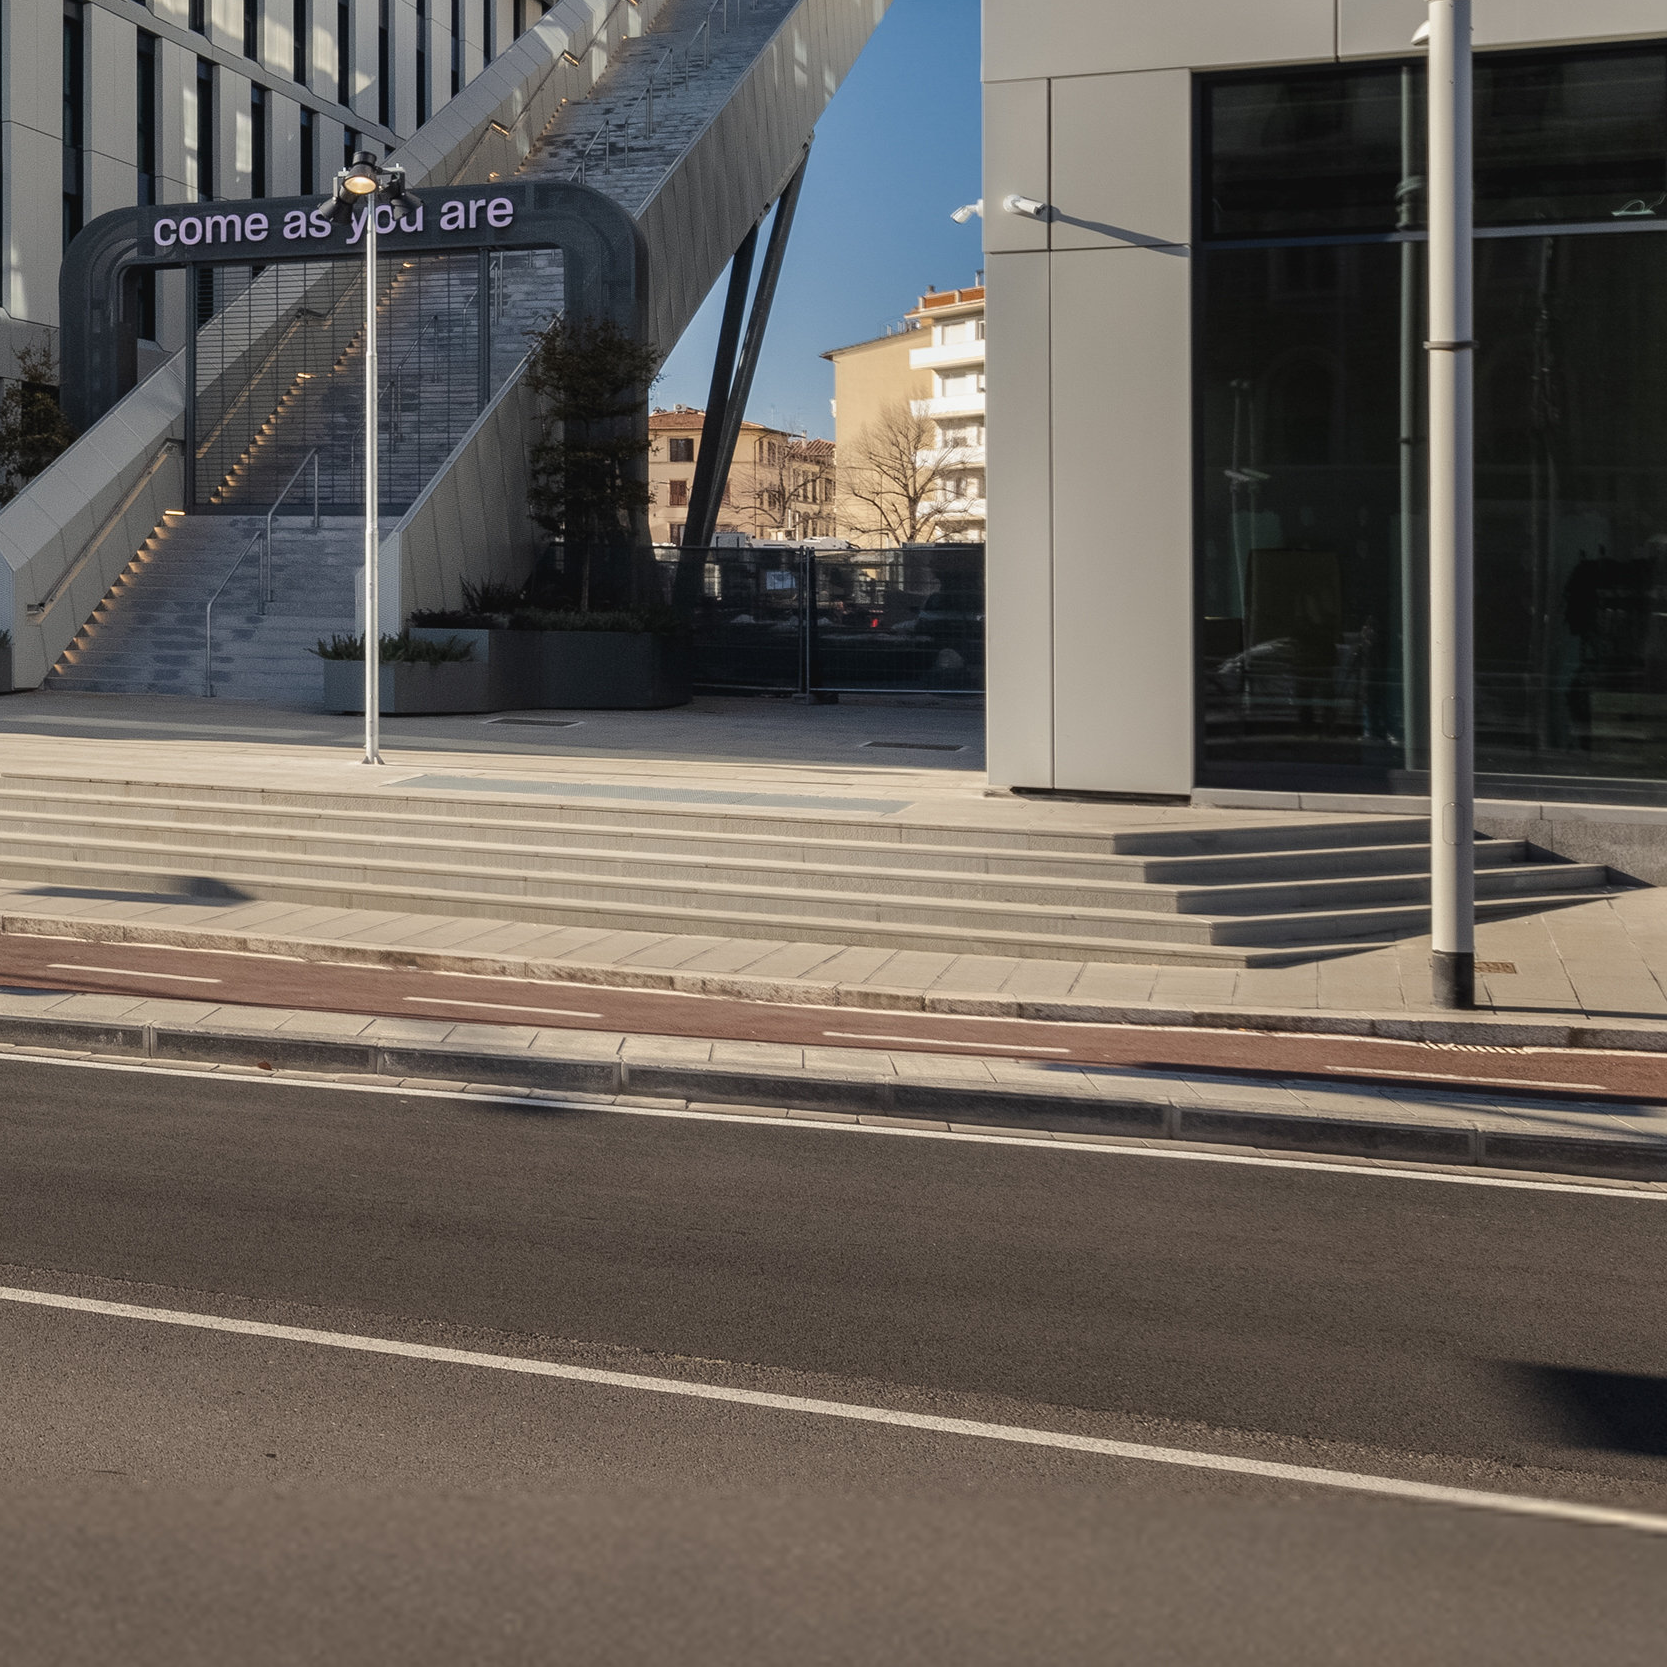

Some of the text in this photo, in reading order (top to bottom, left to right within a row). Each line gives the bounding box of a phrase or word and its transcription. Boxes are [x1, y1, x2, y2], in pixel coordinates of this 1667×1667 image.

[154, 196, 514, 246] come as you are
